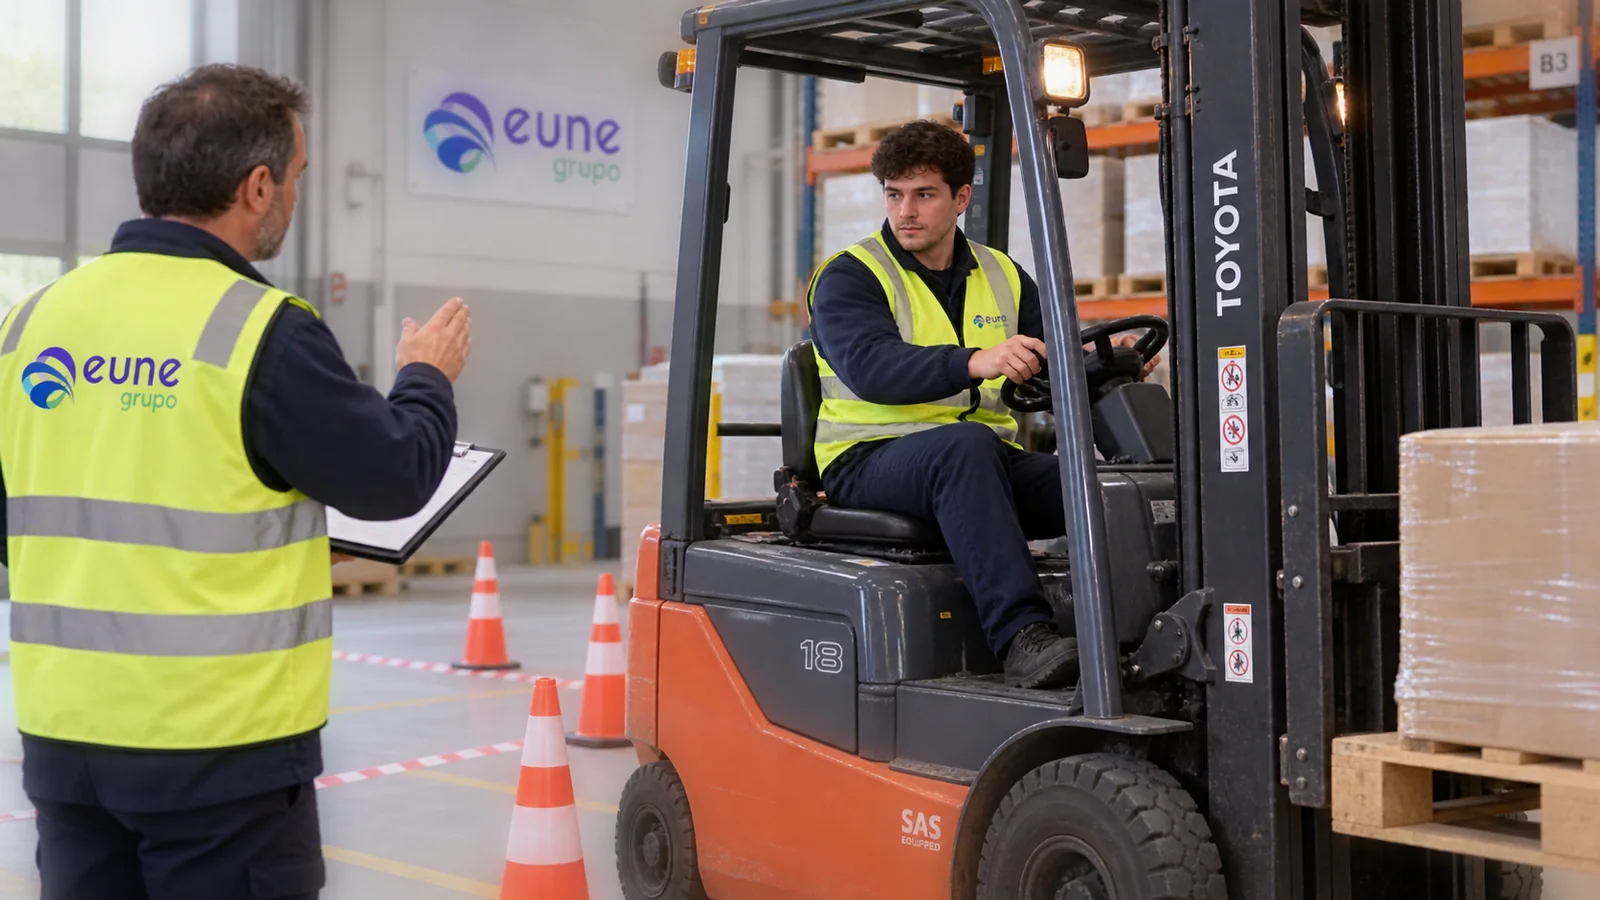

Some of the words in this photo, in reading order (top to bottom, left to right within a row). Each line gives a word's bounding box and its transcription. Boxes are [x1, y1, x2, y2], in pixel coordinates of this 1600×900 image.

[1541, 52, 1568, 73] B3
[504, 108, 620, 155] eune
[553, 158, 621, 186] grupo
[1213, 149, 1242, 317] TOYOTA
[83, 355, 182, 388] eune
[120, 391, 178, 413] grupo
[800, 639, 843, 674] 18
[901, 808, 942, 840] SAS
